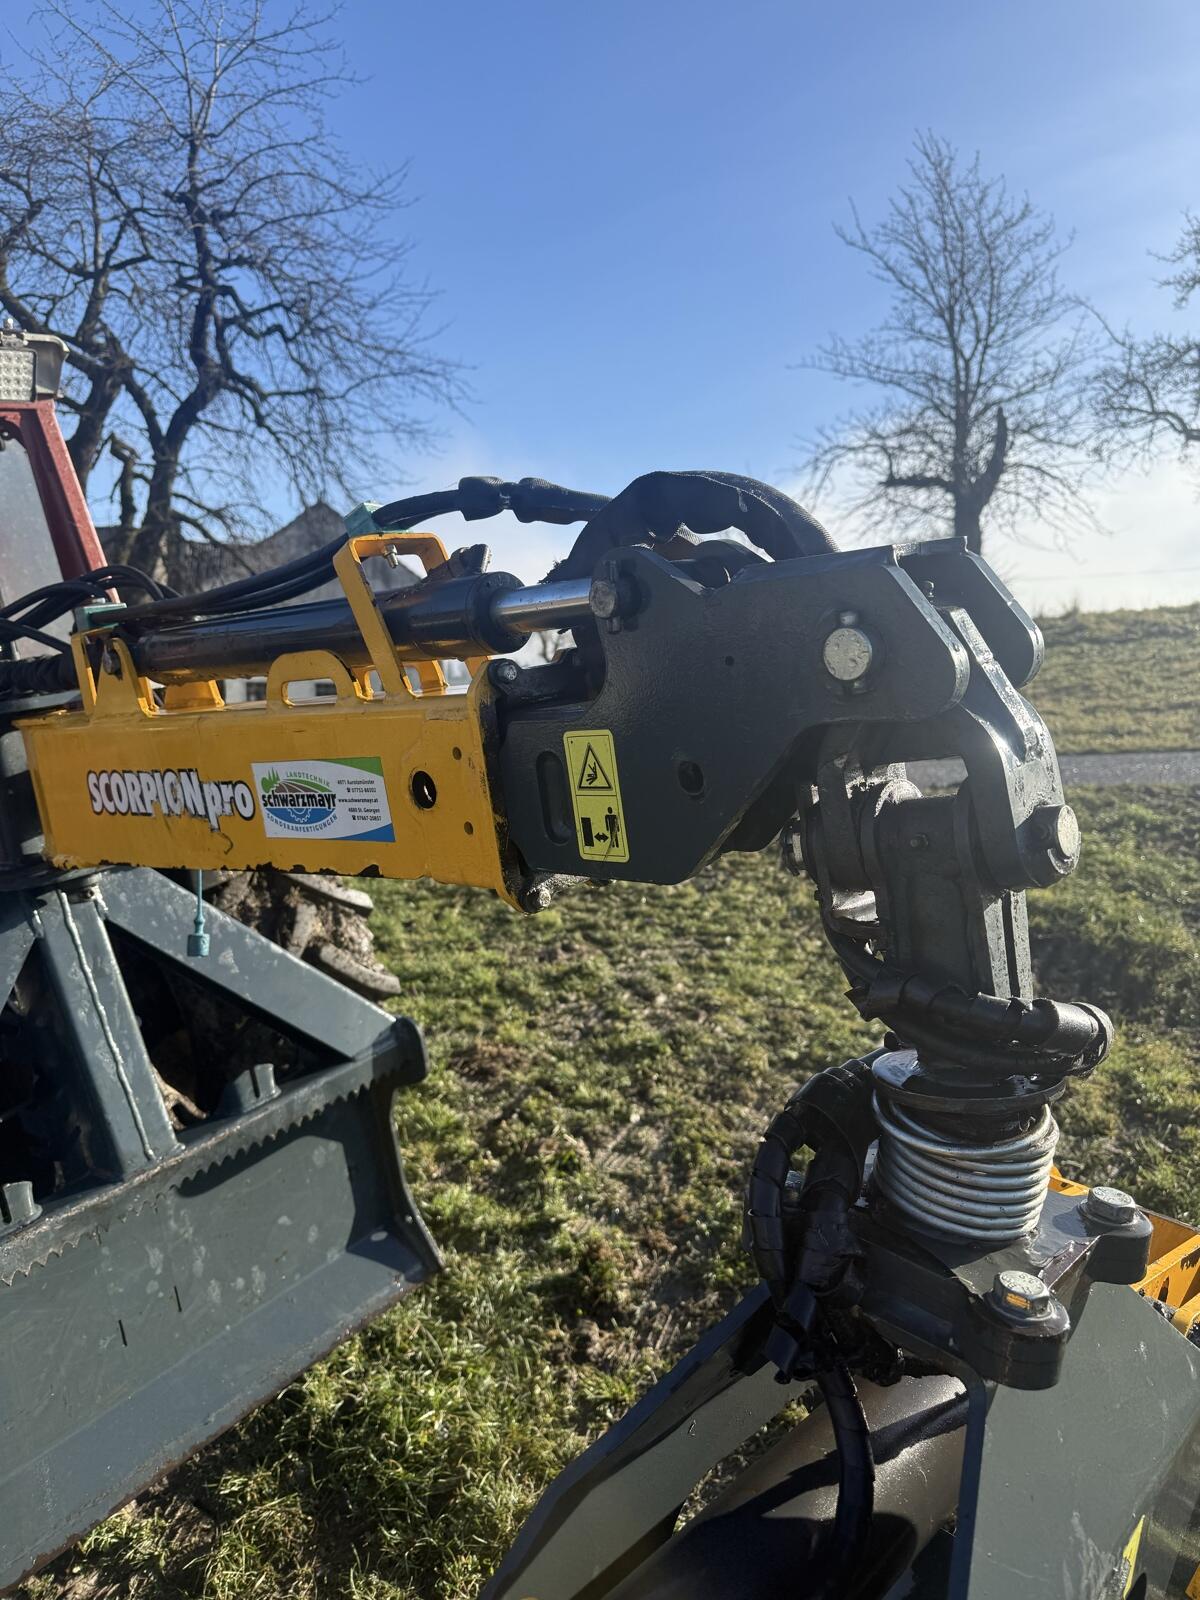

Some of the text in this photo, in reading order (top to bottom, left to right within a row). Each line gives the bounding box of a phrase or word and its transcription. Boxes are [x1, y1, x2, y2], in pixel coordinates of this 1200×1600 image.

[286, 771, 330, 787] LANDTECHNIK
[87, 768, 206, 818] SCORPION
[261, 789, 337, 810] schwarzmayr
[363, 807, 381, 815] Georgen
[266, 813, 338, 833] SONDERANFERTIGUNGEN
